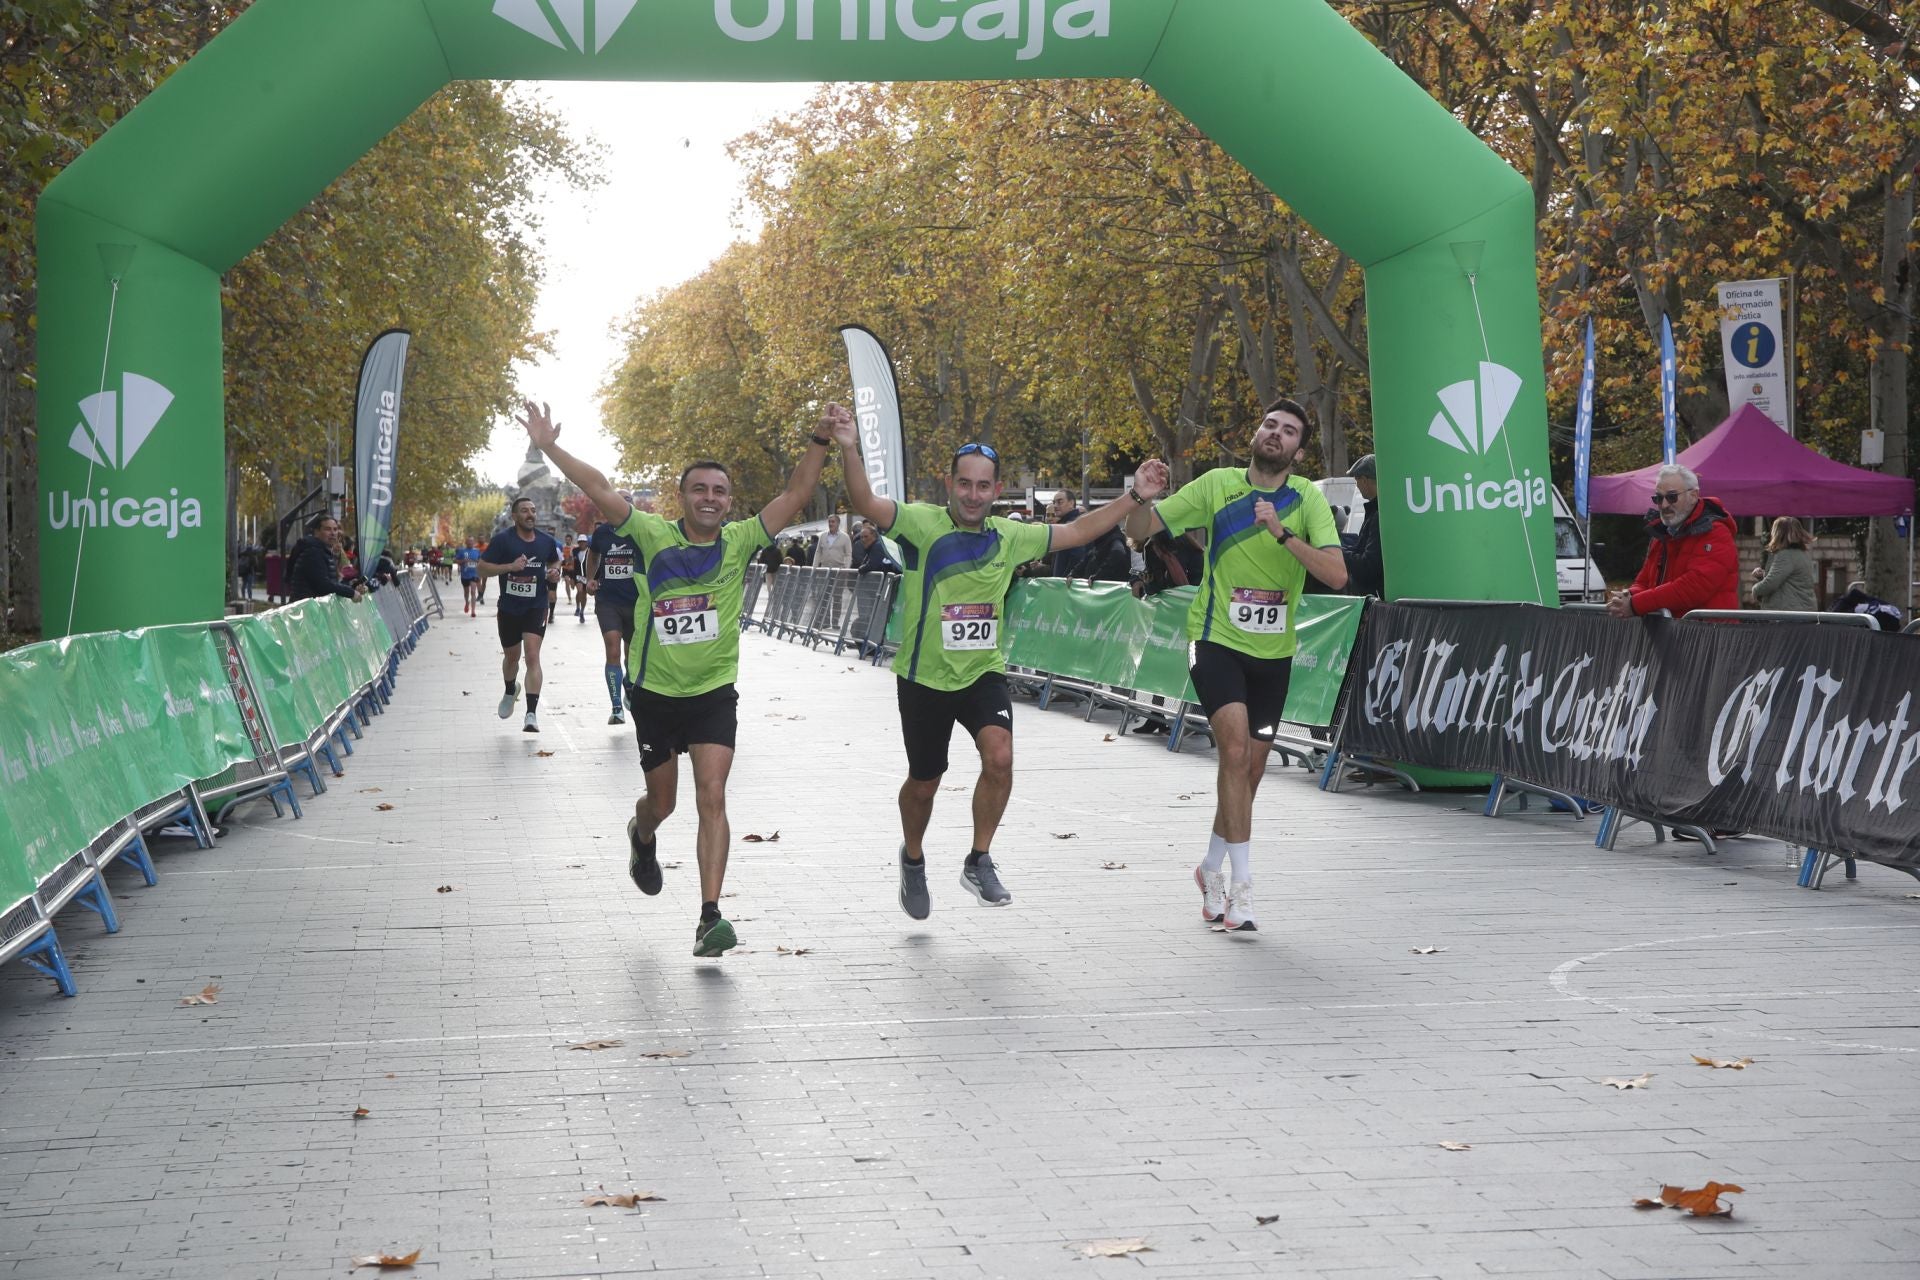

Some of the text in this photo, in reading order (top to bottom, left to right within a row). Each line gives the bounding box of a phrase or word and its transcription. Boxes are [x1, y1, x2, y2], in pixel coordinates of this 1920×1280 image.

[1726, 288, 1764, 299] Oficina de
[371, 390, 396, 507] Unicaja
[1405, 468, 1546, 518] Unicaja
[49, 487, 201, 539] Unicaja
[608, 565, 629, 575] 664
[511, 582, 532, 593] 663
[663, 613, 706, 635] 921
[1238, 605, 1279, 625] 919
[951, 622, 991, 641] 920
[1708, 666, 1785, 787] El
